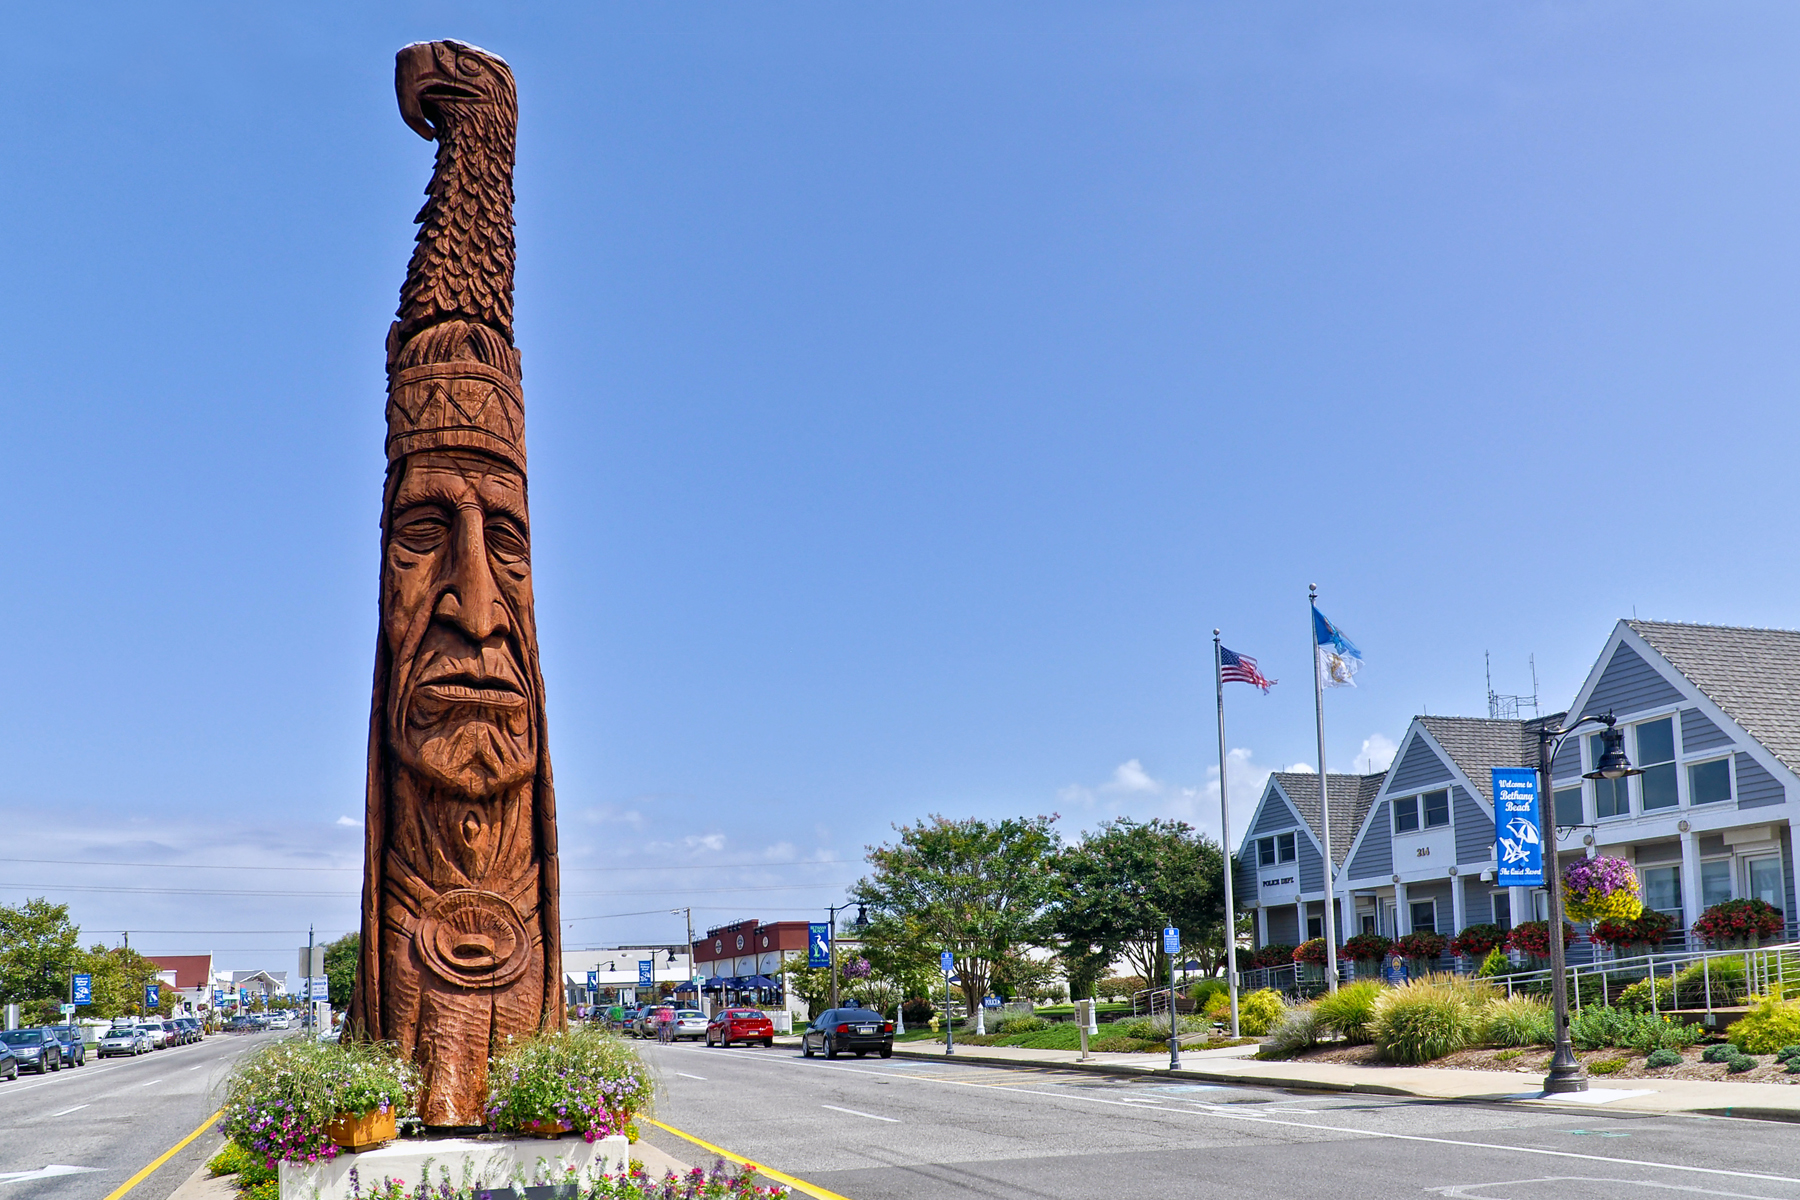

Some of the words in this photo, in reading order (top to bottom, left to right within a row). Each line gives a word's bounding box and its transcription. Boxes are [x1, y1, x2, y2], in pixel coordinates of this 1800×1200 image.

[1498, 779, 1526, 788] Welcome
[1526, 780, 1533, 788] to
[1499, 790, 1534, 803] Bethany
[1505, 801, 1531, 812] Beach
[1499, 867, 1510, 875] The
[1524, 867, 1541, 875] Resort
[1262, 879, 1280, 887] POLICE
